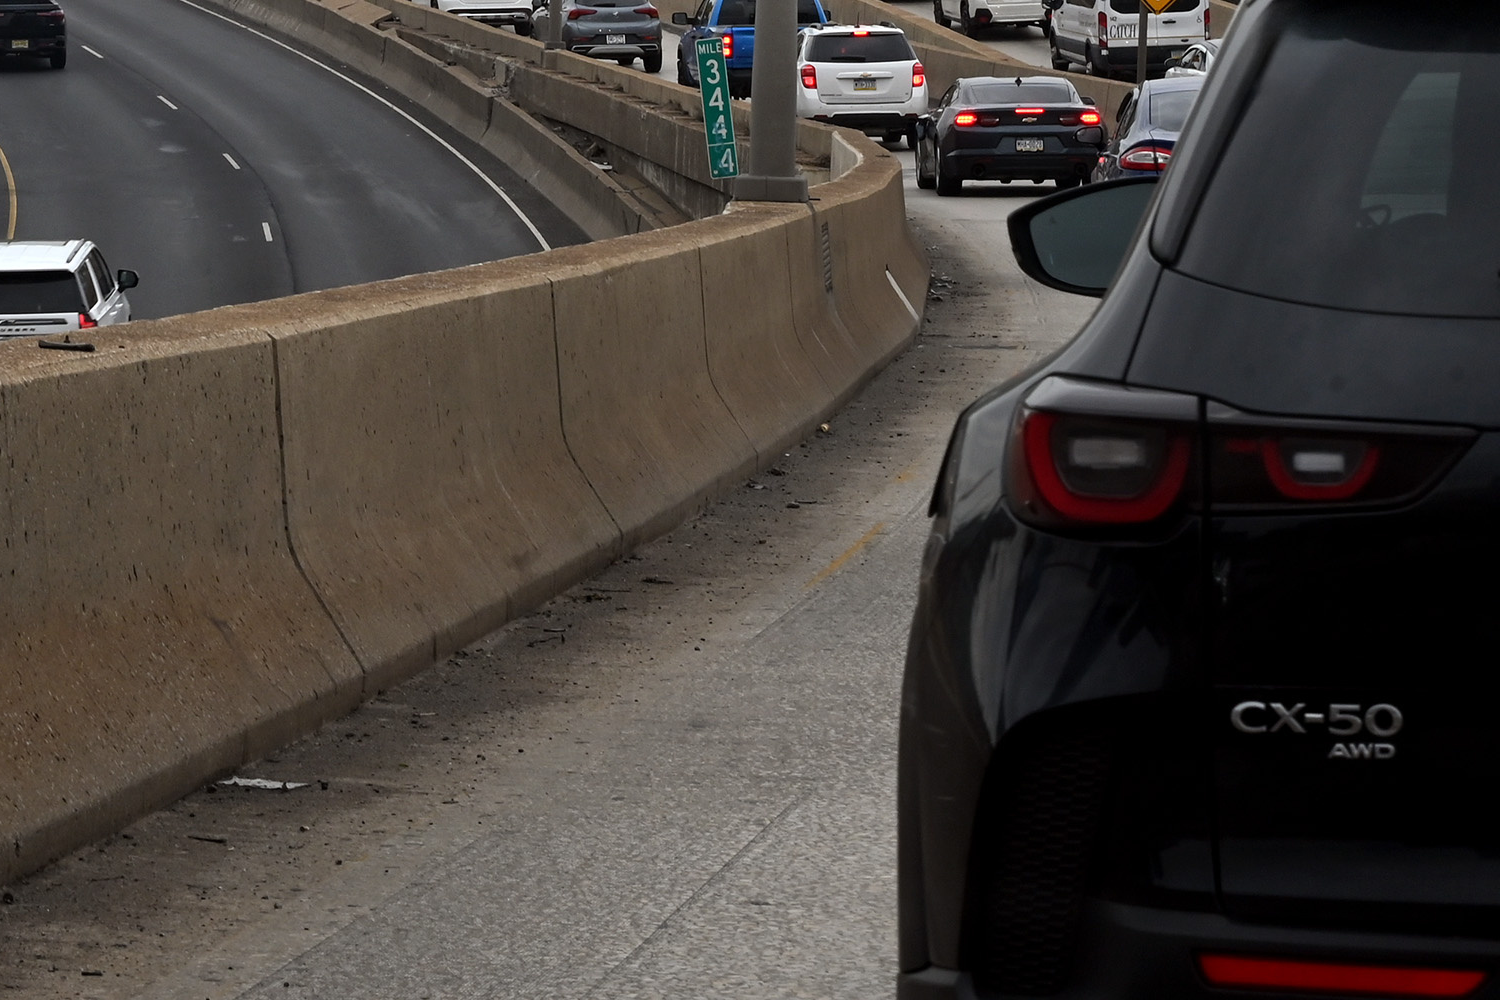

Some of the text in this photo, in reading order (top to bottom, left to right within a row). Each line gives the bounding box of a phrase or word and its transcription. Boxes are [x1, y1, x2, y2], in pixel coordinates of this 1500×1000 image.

[1109, 23, 1138, 38] CATCH
[698, 41, 723, 55] MILE
[1231, 701, 1404, 737] CX-50
[1328, 743, 1396, 759] AWD
